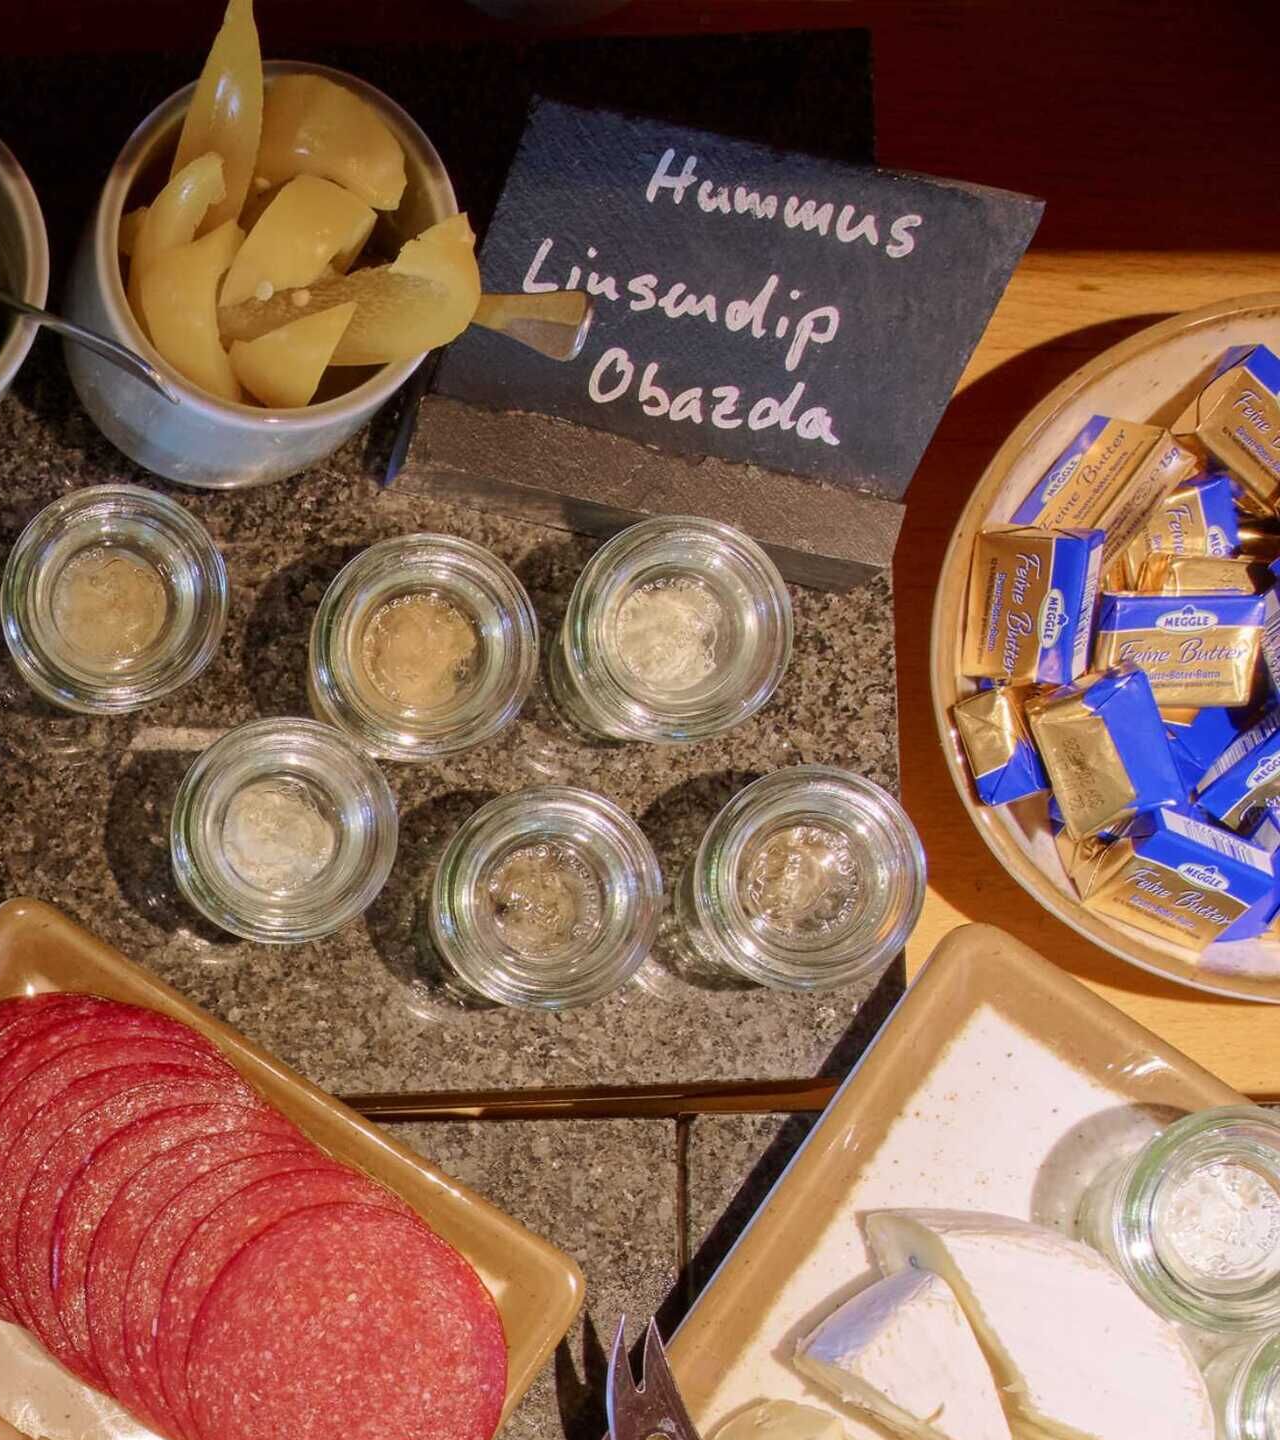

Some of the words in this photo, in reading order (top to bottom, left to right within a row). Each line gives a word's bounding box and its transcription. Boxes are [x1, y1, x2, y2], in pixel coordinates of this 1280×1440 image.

[645, 147, 924, 259] Hummus
[522, 238, 841, 372] Linsendip
[588, 346, 842, 447] Obazda
[1231, 388, 1272, 434] Feine
[1046, 459, 1081, 498] MEGGLE
[1076, 428, 1127, 489] Butter
[1011, 552, 1041, 606] Feine
[1002, 608, 1033, 678] Butter
[1042, 596, 1059, 640] MEGGLE
[1163, 615, 1210, 628] MEGGLE
[1119, 638, 1172, 664] Feine
[1177, 636, 1249, 665] Butter
[1123, 864, 1175, 900] Feine
[1172, 888, 1235, 928] Butter
[1182, 864, 1224, 889] MEGGLE
